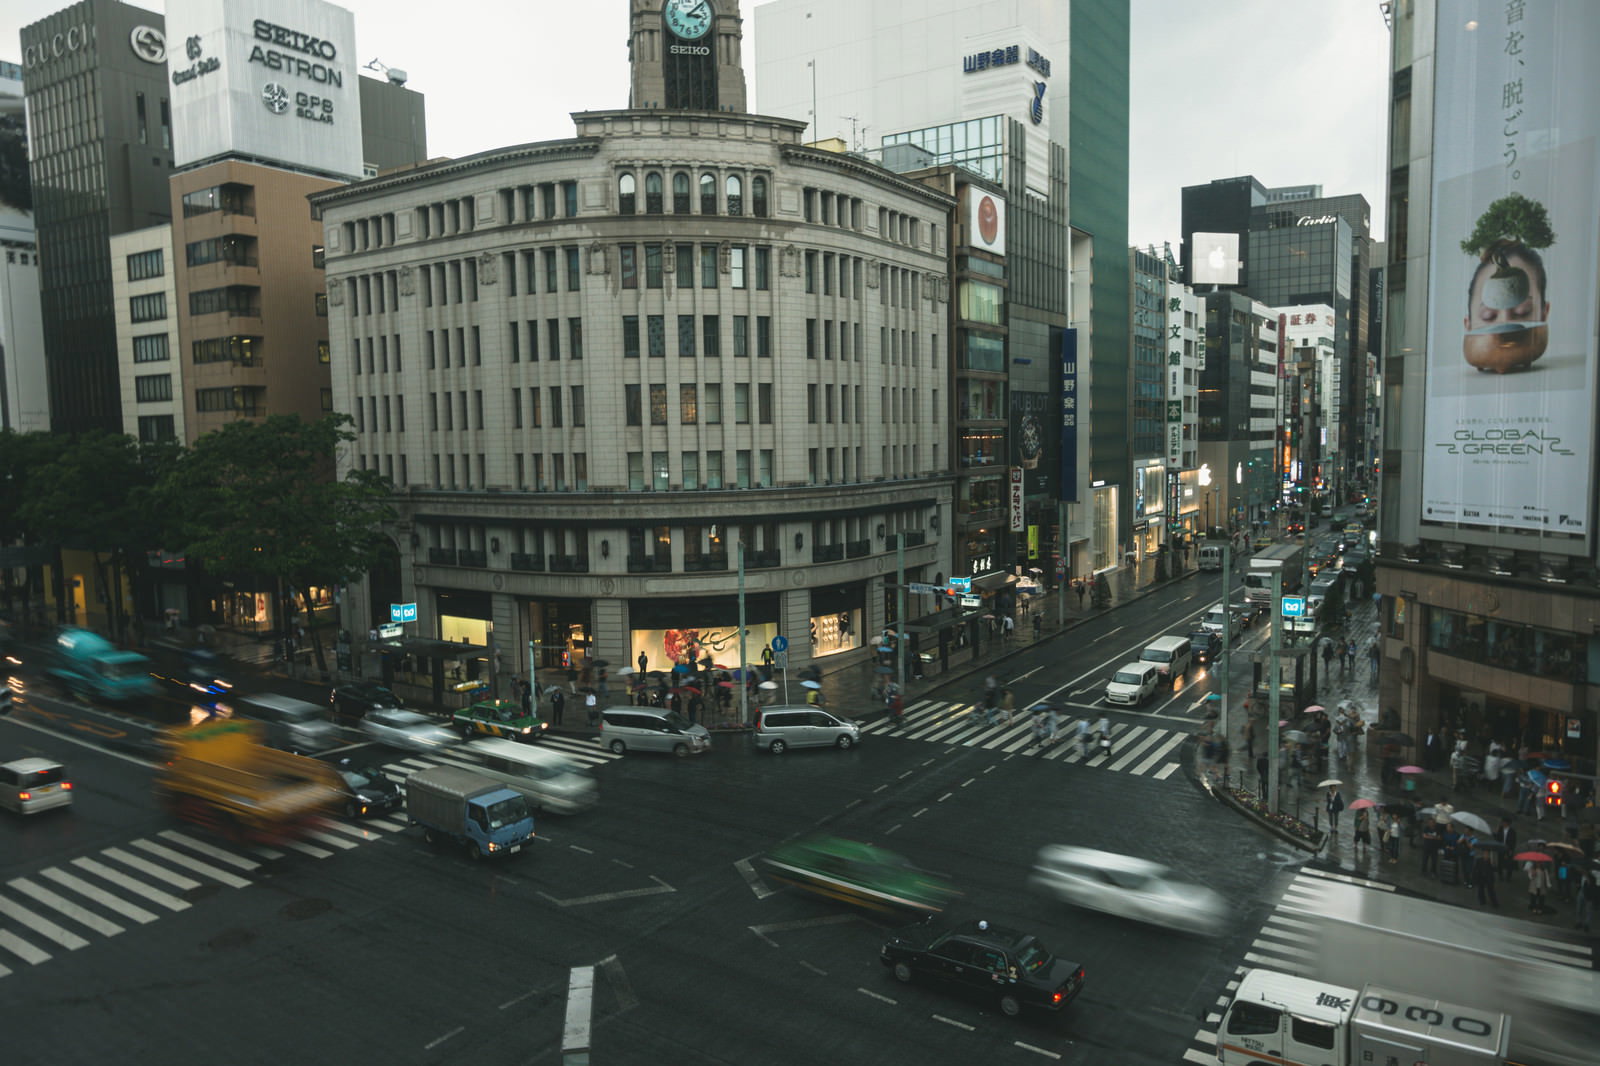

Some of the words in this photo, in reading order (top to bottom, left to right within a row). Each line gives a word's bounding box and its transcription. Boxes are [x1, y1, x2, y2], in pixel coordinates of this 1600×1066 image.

[25, 23, 87, 68] GUCCI
[253, 18, 337, 61] SEIKO
[670, 45, 710, 55] SEIKO
[249, 46, 343, 88] ASTRON
[963, 45, 1019, 73] 山野楽器
[296, 92, 334, 113] GPS
[296, 108, 334, 125] SOLAR
[1168, 297, 1181, 365] 教文館
[1063, 362, 1075, 426] 山野楽器
[1454, 429, 1556, 441] GLOBAL
[1463, 444, 1543, 455] GREEN
